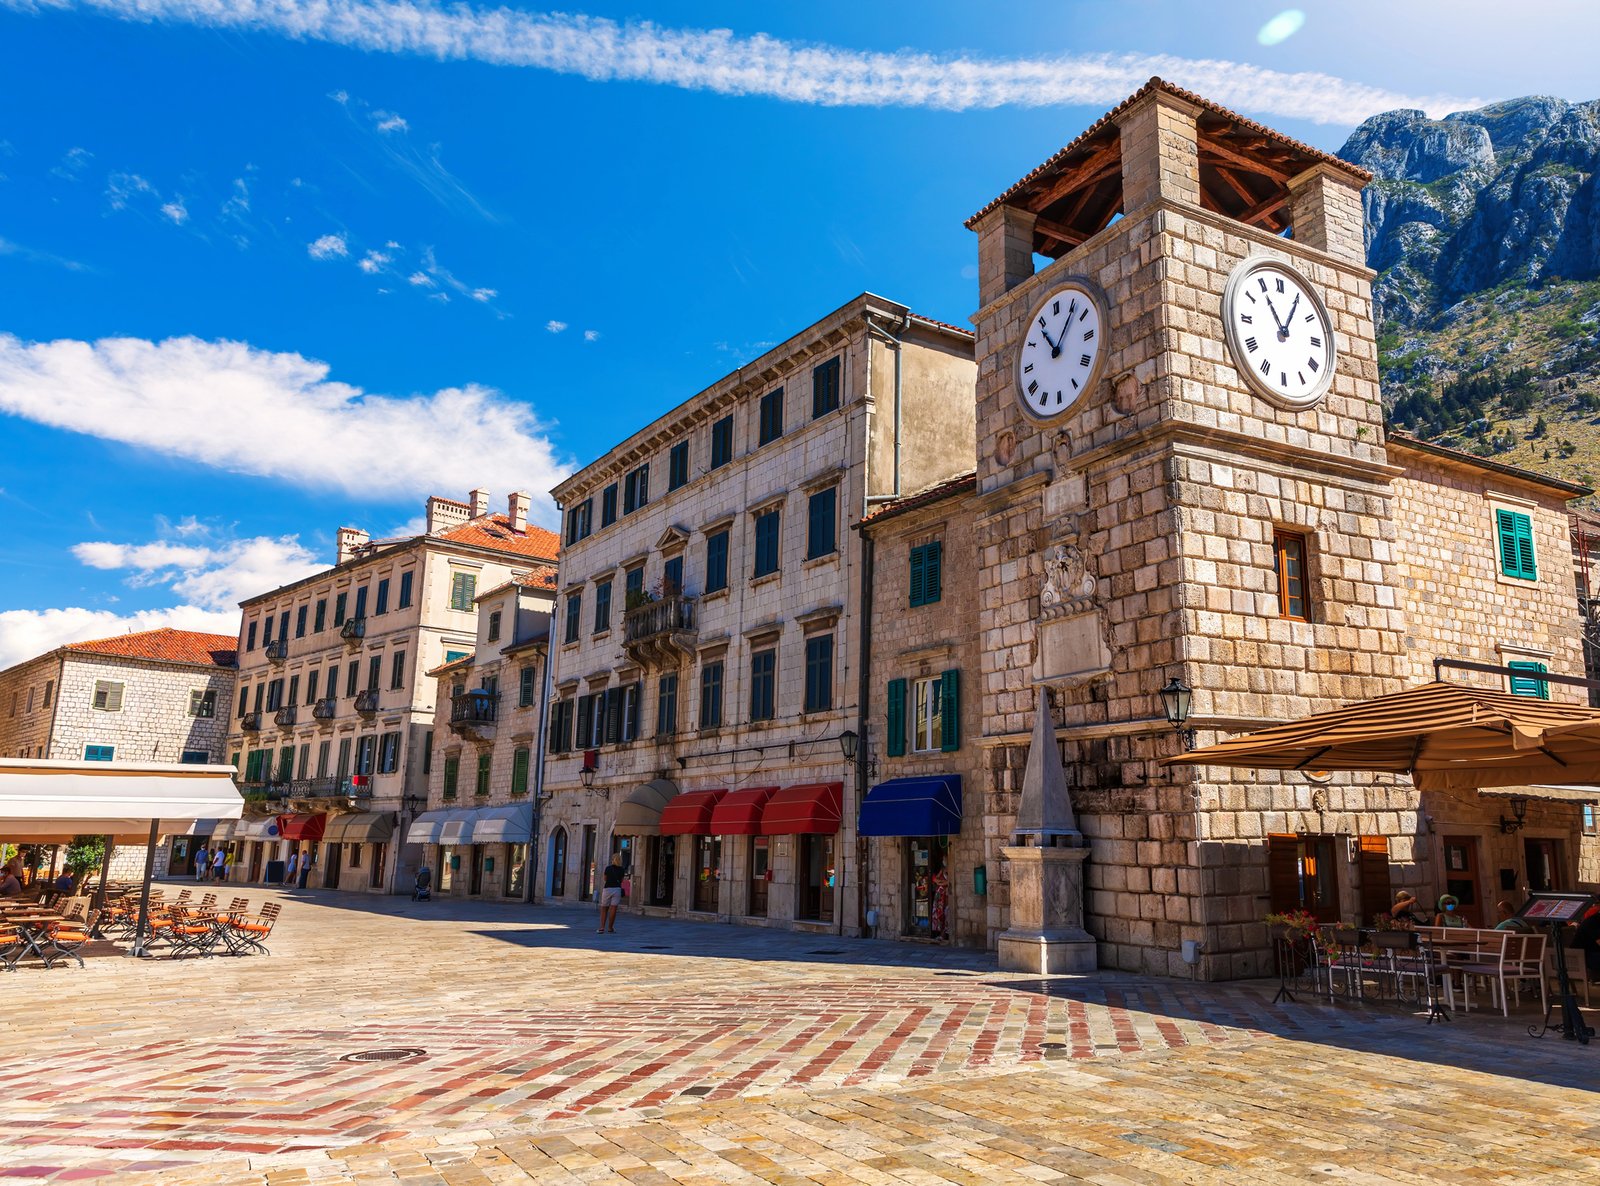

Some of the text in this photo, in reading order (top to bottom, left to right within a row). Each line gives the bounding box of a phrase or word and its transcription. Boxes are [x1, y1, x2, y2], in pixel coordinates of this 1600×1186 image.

[1245, 290, 1256, 305] X
[1240, 313, 1252, 325] IX
[1304, 313, 1315, 323] II
[1084, 329, 1094, 342] III
[1310, 336, 1321, 348] III
[1071, 378, 1078, 390] V
[1298, 371, 1306, 386] V
